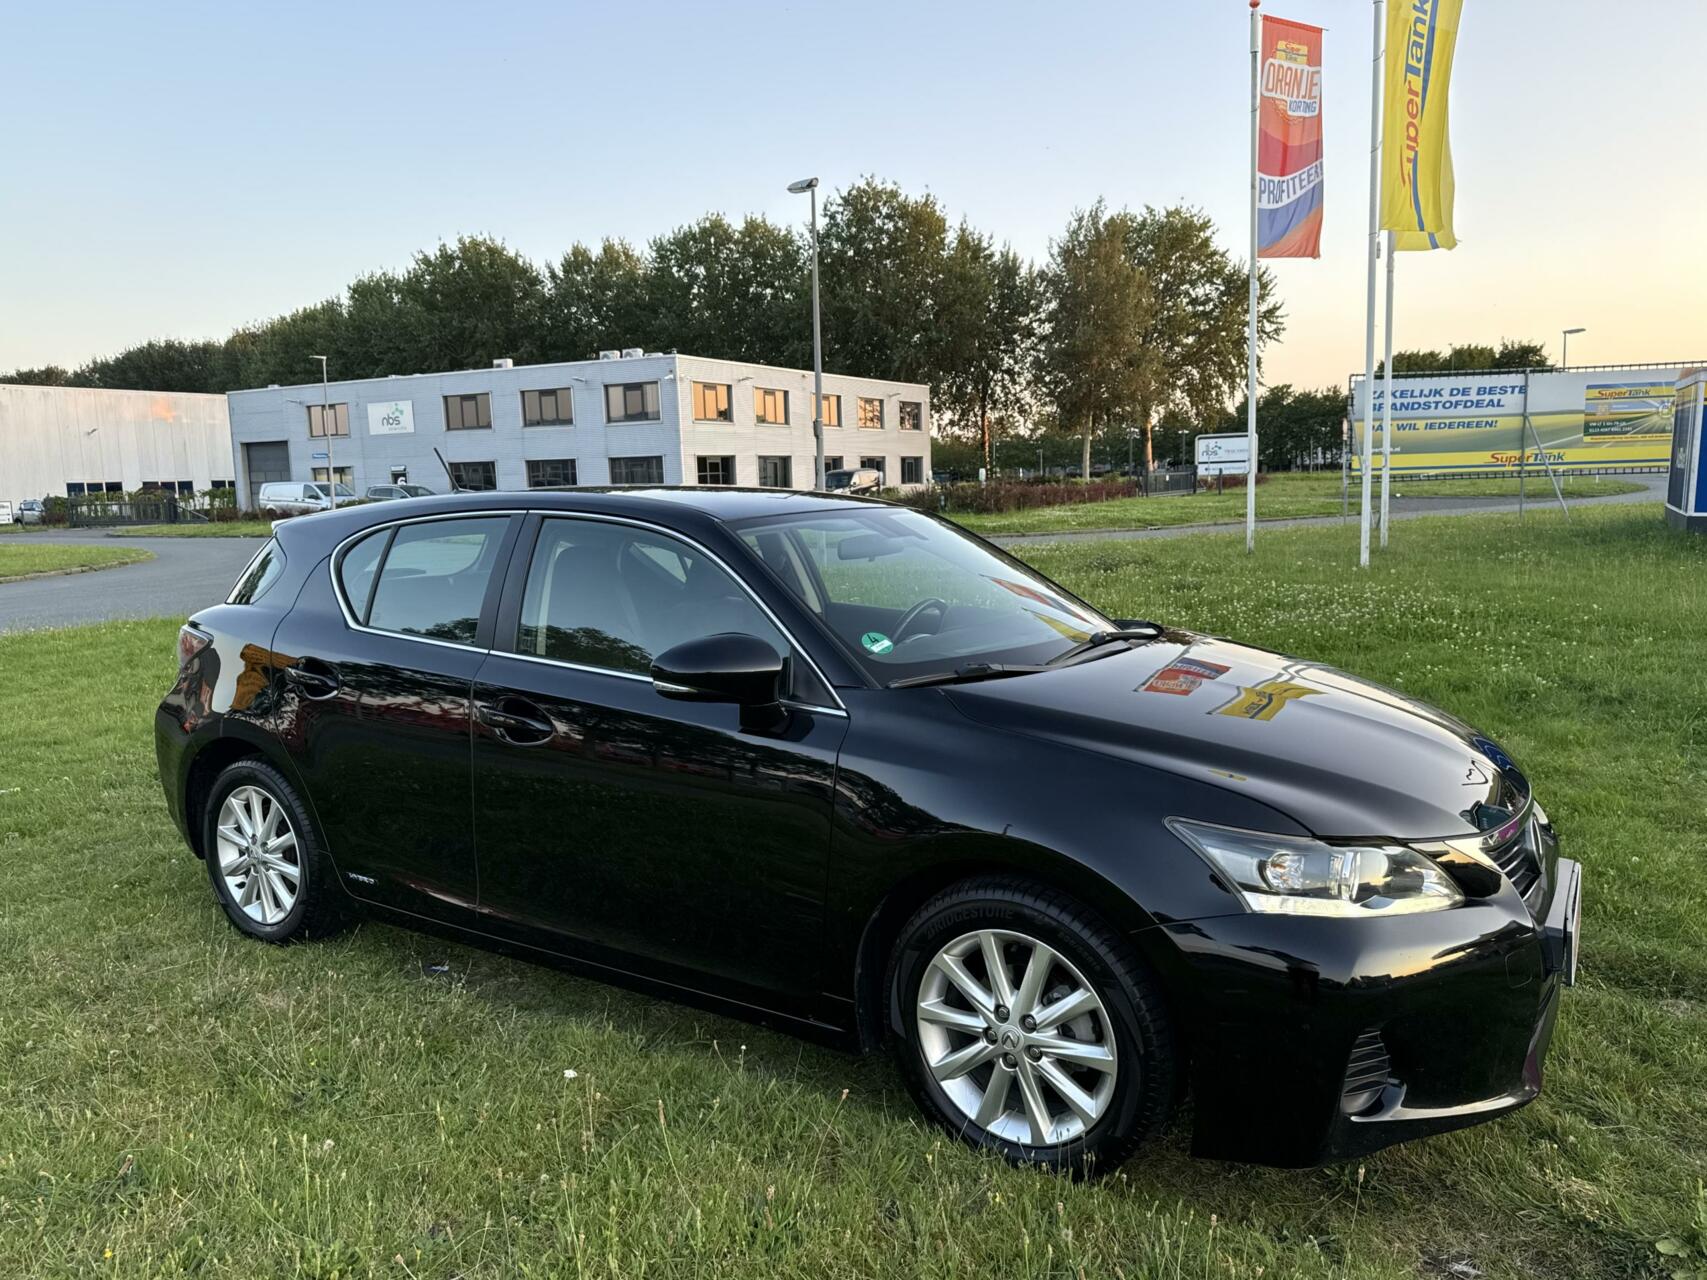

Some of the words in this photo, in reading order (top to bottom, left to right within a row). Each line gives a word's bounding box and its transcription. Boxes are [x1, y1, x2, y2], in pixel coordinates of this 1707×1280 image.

[1264, 62, 1320, 100] ORANJE
[1289, 100, 1317, 113] KORTING
[1449, 387, 1472, 397] DE
[1476, 385, 1528, 396] BESTE
[1598, 389, 1651, 400] SuperTank
[381, 413, 401, 426] nbs
[1396, 422, 1420, 431] WIL
[1424, 420, 1498, 431] IEDEREEN!
